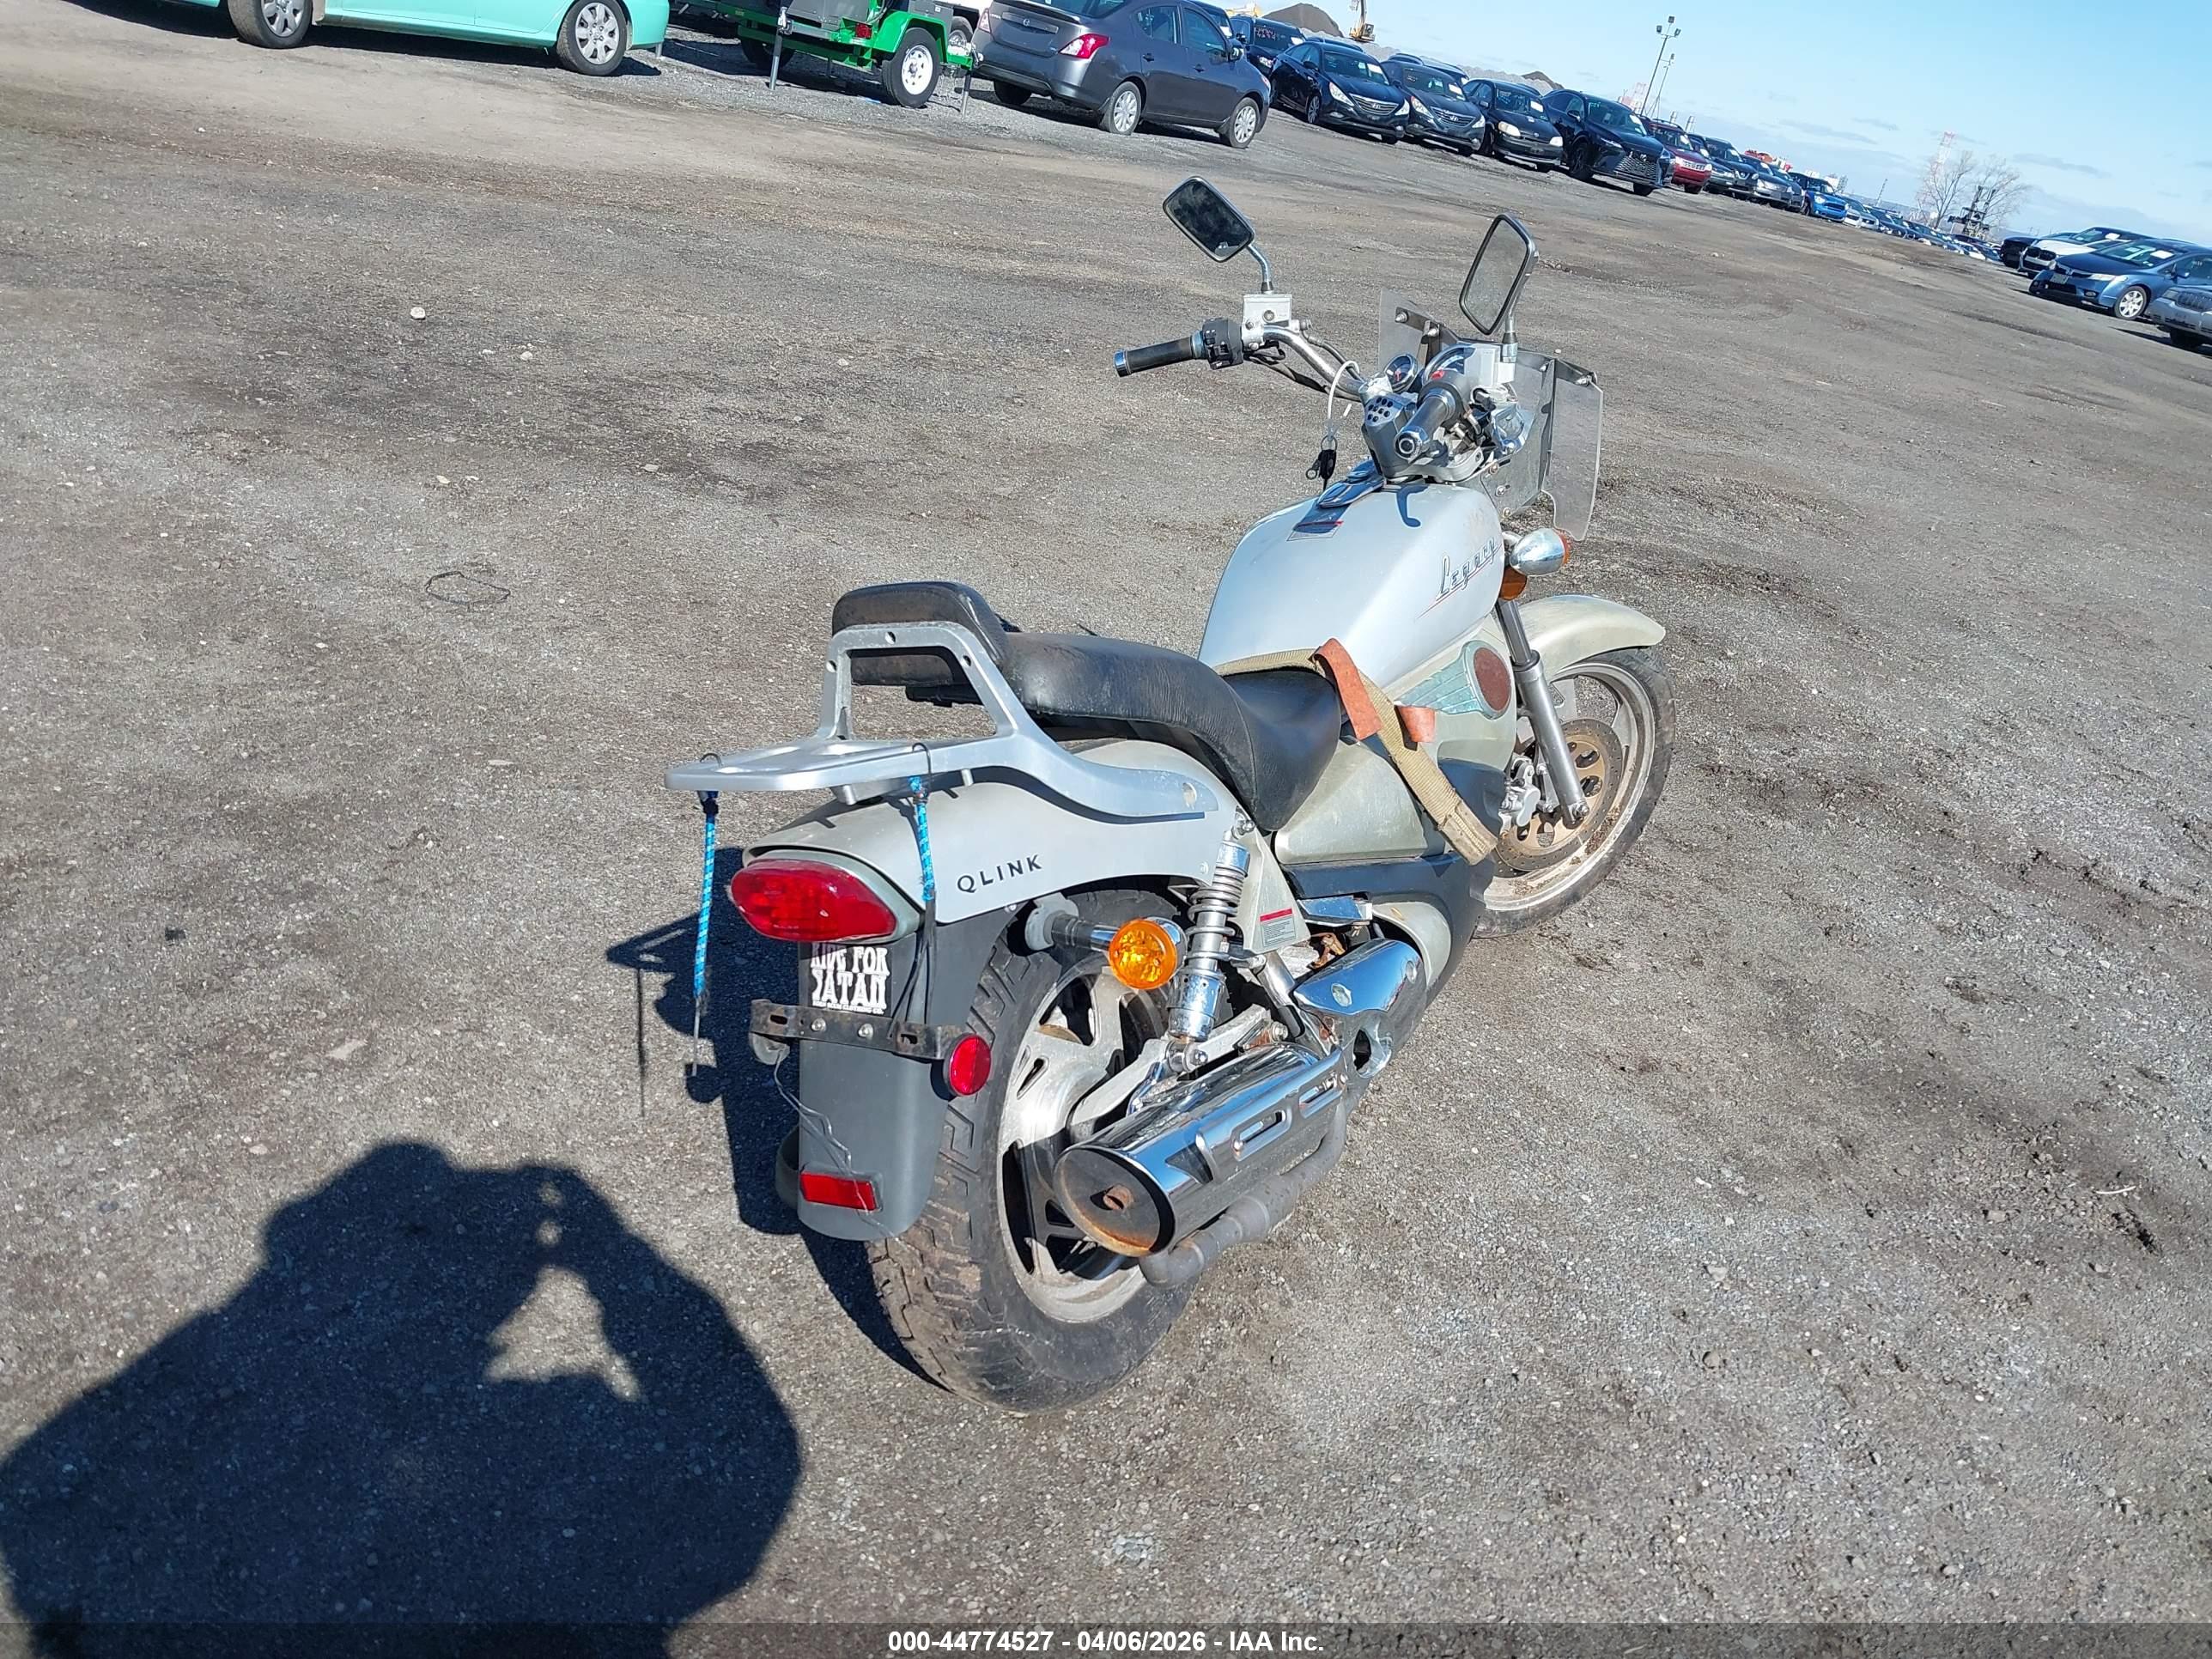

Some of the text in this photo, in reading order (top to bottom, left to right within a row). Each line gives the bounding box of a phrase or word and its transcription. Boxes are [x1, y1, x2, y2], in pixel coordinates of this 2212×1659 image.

[1437, 537, 1500, 598] Legacy
[957, 854, 1042, 893] QLINK
[852, 946, 890, 975] FOR
[811, 969, 887, 1010] SATAN
